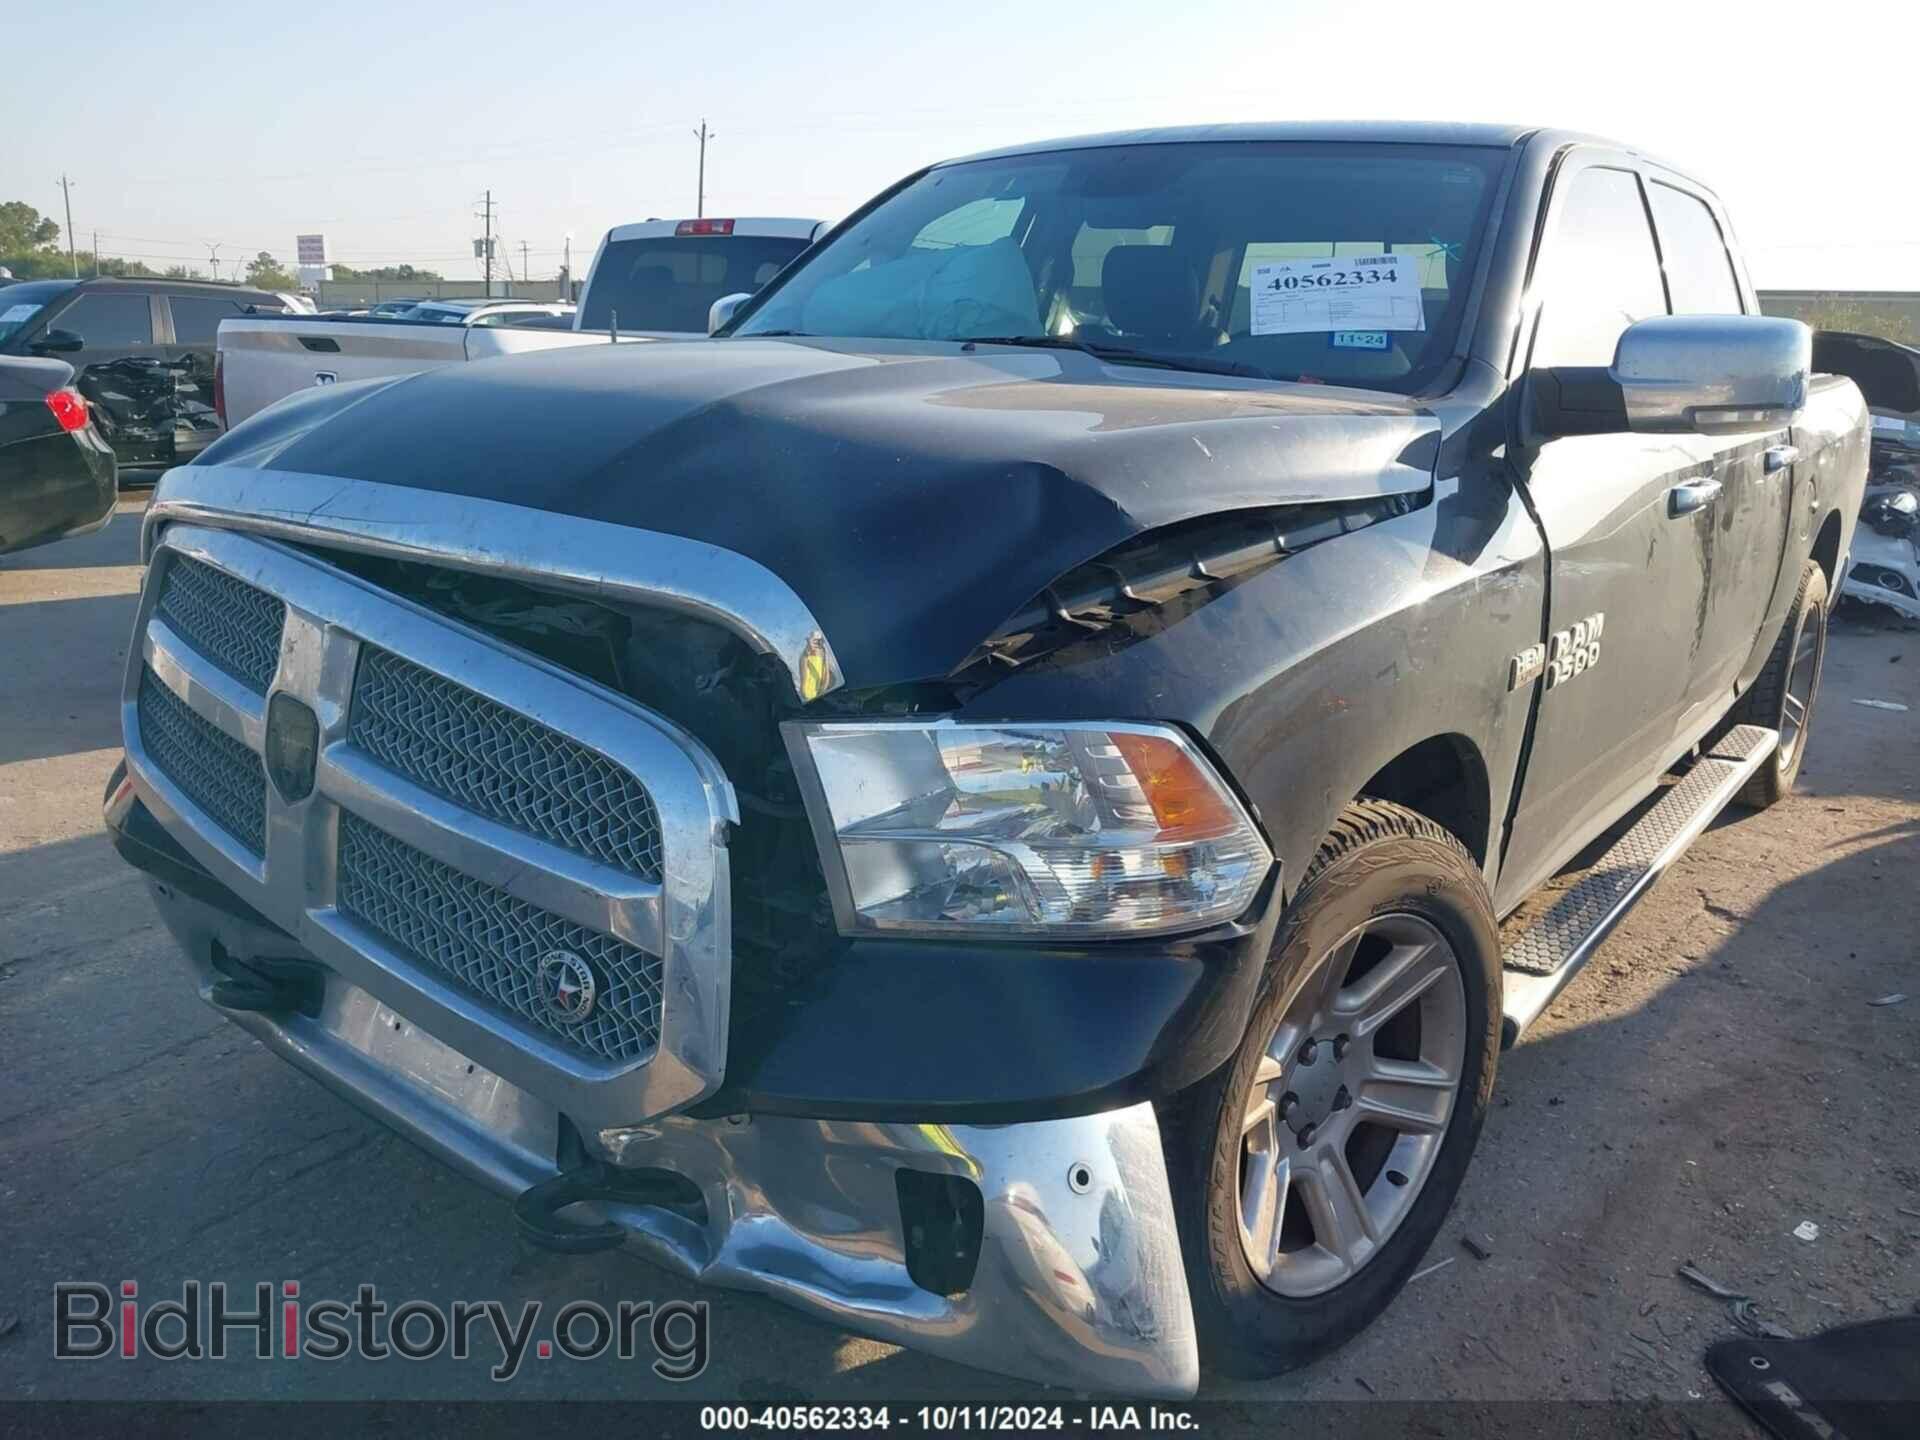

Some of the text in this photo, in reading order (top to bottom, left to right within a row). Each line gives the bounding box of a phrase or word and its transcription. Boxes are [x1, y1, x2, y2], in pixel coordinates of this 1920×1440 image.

[1267, 269, 1399, 291] 40562334
[1550, 611, 1605, 661] RAM
[1547, 641, 1600, 690] 1500
